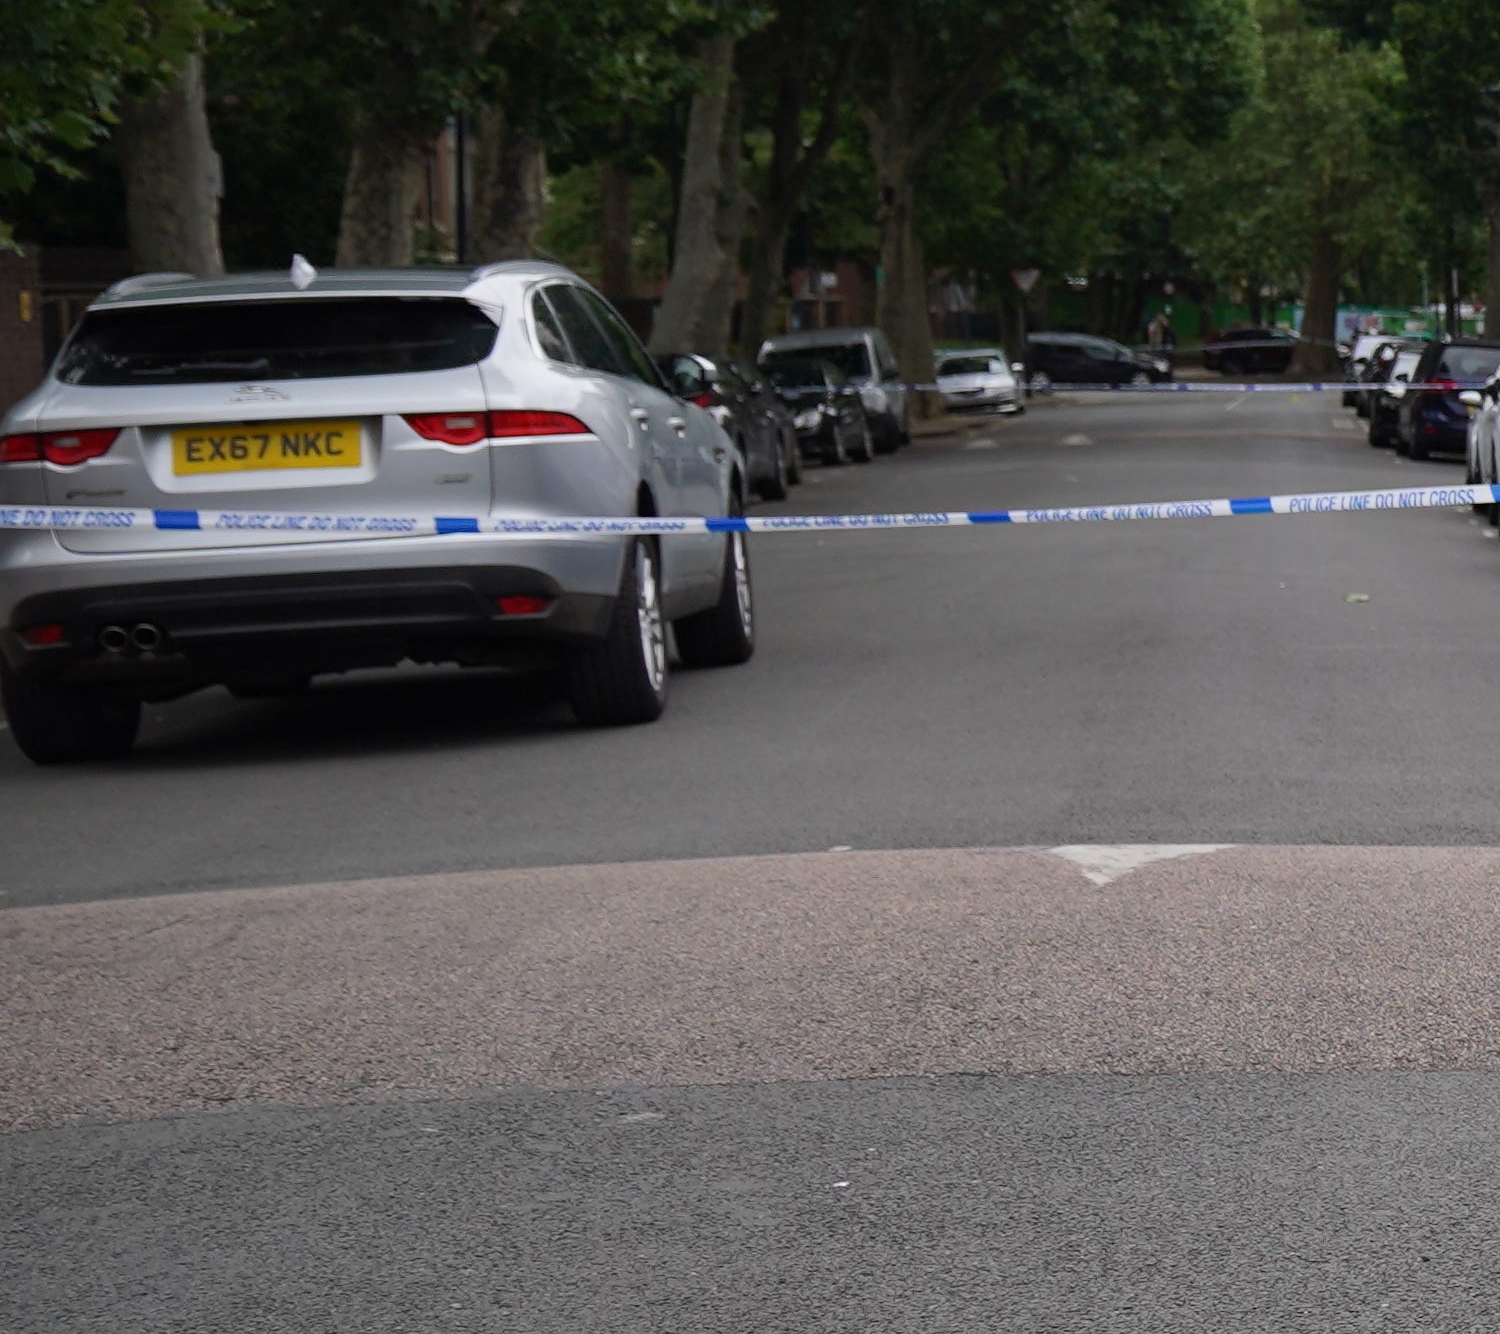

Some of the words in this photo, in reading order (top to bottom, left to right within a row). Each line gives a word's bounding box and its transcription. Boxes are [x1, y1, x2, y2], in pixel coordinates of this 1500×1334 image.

[185, 434, 269, 463] EX67
[281, 431, 344, 457] NKC
[1290, 496, 1336, 513] POLICE
[1341, 495, 1370, 511] LINE
[1376, 493, 1394, 509] DO
[1399, 492, 1425, 508] NOT
[1430, 489, 1474, 506] CROSS
